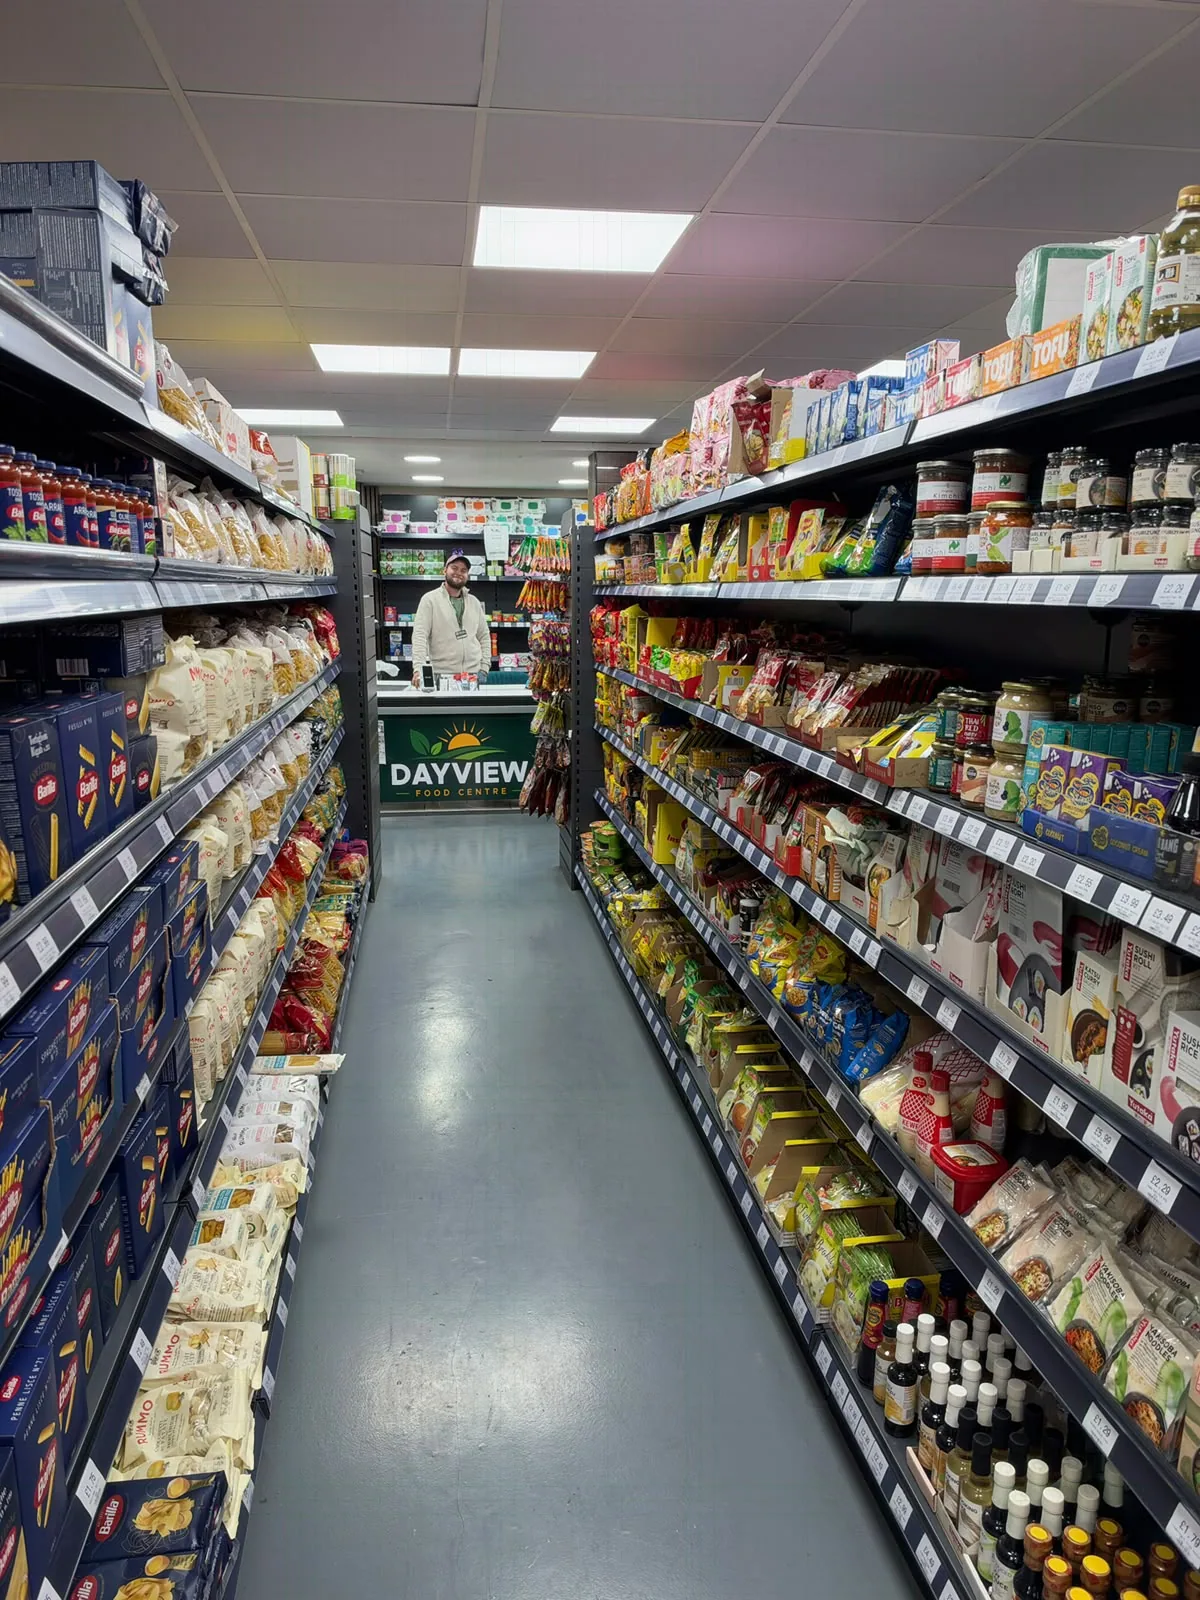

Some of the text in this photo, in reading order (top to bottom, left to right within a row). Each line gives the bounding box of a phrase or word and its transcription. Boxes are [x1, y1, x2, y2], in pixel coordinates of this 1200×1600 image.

[1034, 330, 1070, 369] TOFU
[906, 349, 932, 381] TOFU
[984, 350, 1015, 384] TOFU
[947, 363, 974, 398] TOFU
[1163, 583, 1185, 594] £2.29
[126, 702, 138, 716] Barilla
[965, 717, 980, 725] THAI
[964, 724, 979, 732] RED
[111, 758, 127, 780] Barilla
[390, 760, 529, 786] DAYVIEW
[37, 780, 57, 801] Barilla
[79, 776, 98, 799] Barilla
[139, 776, 149, 792] Barilla
[415, 787, 508, 797] FOOD CENTRE
[1045, 828, 1065, 842] COCONUT
[1021, 855, 1037, 867] £2.20
[1075, 874, 1094, 888] £2.55
[1120, 893, 1140, 909] £3.99
[1153, 908, 1174, 924] £3.49
[1124, 943, 1134, 981] Yutaka
[1133, 955, 1152, 970] ROLL
[1134, 946, 1156, 962] SUSHI
[1083, 972, 1100, 987] CURRY
[1084, 965, 1101, 980] KATSU
[70, 1003, 88, 1035] Barilla
[1170, 1028, 1181, 1070] Yutaka
[1180, 1043, 1199, 1060] RICE
[1181, 1032, 1200, 1048] SUSH
[80, 1061, 97, 1096] Barilla
[1052, 1095, 1069, 1112] £1.99
[1129, 1097, 1153, 1122] Yutaka
[1094, 1127, 1112, 1145] £5.99
[140, 1178, 156, 1212] Barilla
[1149, 1174, 1172, 1196] £2.29
[1073, 1209, 1090, 1225] UDON
[107, 1233, 120, 1263] Barilla
[985, 1278, 1000, 1296] £1.29
[1101, 1262, 1125, 1298] YAKISOBA
[1160, 1268, 1191, 1290] YAKISOBA
[34, 1280, 67, 1334] PENNE LISCE N°71
[77, 1292, 91, 1326] Barilla
[1129, 1319, 1149, 1350] Yutaka
[1144, 1331, 1171, 1362] NOODLES
[1149, 1324, 1178, 1358] YAKISOBA
[159, 1334, 181, 1375] RUMMO
[2, 1376, 19, 1400] Barilla
[10, 1356, 45, 1421] PENNE LISCE N°71
[57, 1360, 77, 1410] Barilla
[135, 1398, 154, 1446] RUMMO
[1093, 1413, 1112, 1438] £1.29
[38, 1447, 56, 1503] Barilla
[85, 1471, 97, 1498] £1.75
[99, 1498, 120, 1536] Barilla
